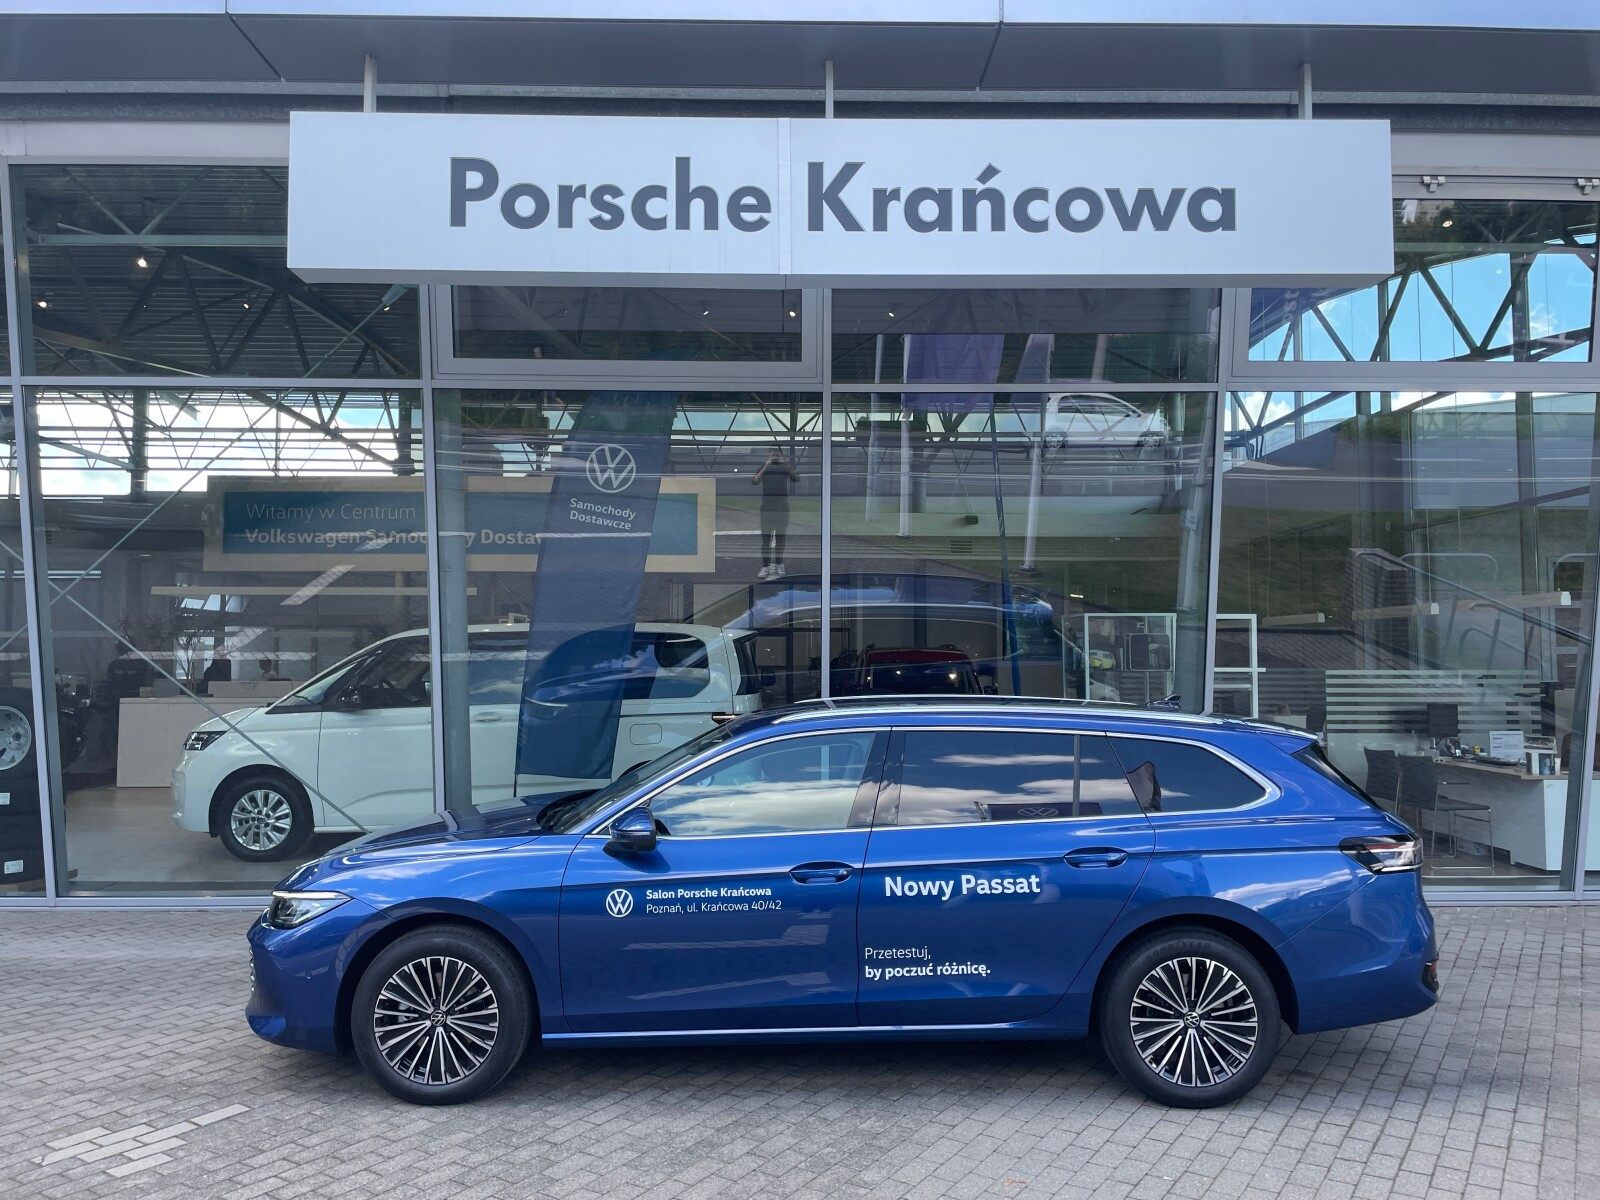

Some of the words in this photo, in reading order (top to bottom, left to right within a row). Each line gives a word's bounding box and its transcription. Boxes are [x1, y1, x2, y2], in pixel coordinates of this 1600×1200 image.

[449, 155, 773, 233] Porsche
[806, 162, 1238, 234] Krańcowa
[246, 503, 313, 523] Witamy
[319, 509, 335, 520] w
[340, 503, 416, 520] Centrum
[570, 498, 636, 521] Samochody
[570, 510, 632, 530] Dostawcze
[245, 528, 360, 548] Volkswagen
[646, 889, 675, 900] Salon
[677, 888, 718, 899] Porsche
[720, 886, 772, 897] Krańcowa
[884, 876, 954, 901] Nowy
[961, 874, 1041, 895] Passat
[646, 903, 684, 914] Poznań,
[687, 901, 699, 913] ul.
[701, 901, 750, 912] Krańcowa
[751, 900, 782, 911] 40/42
[865, 945, 932, 960] Przetestuj,
[865, 966, 882, 981] by
[885, 963, 934, 980] poczuć
[937, 961, 991, 977] różnicę.
